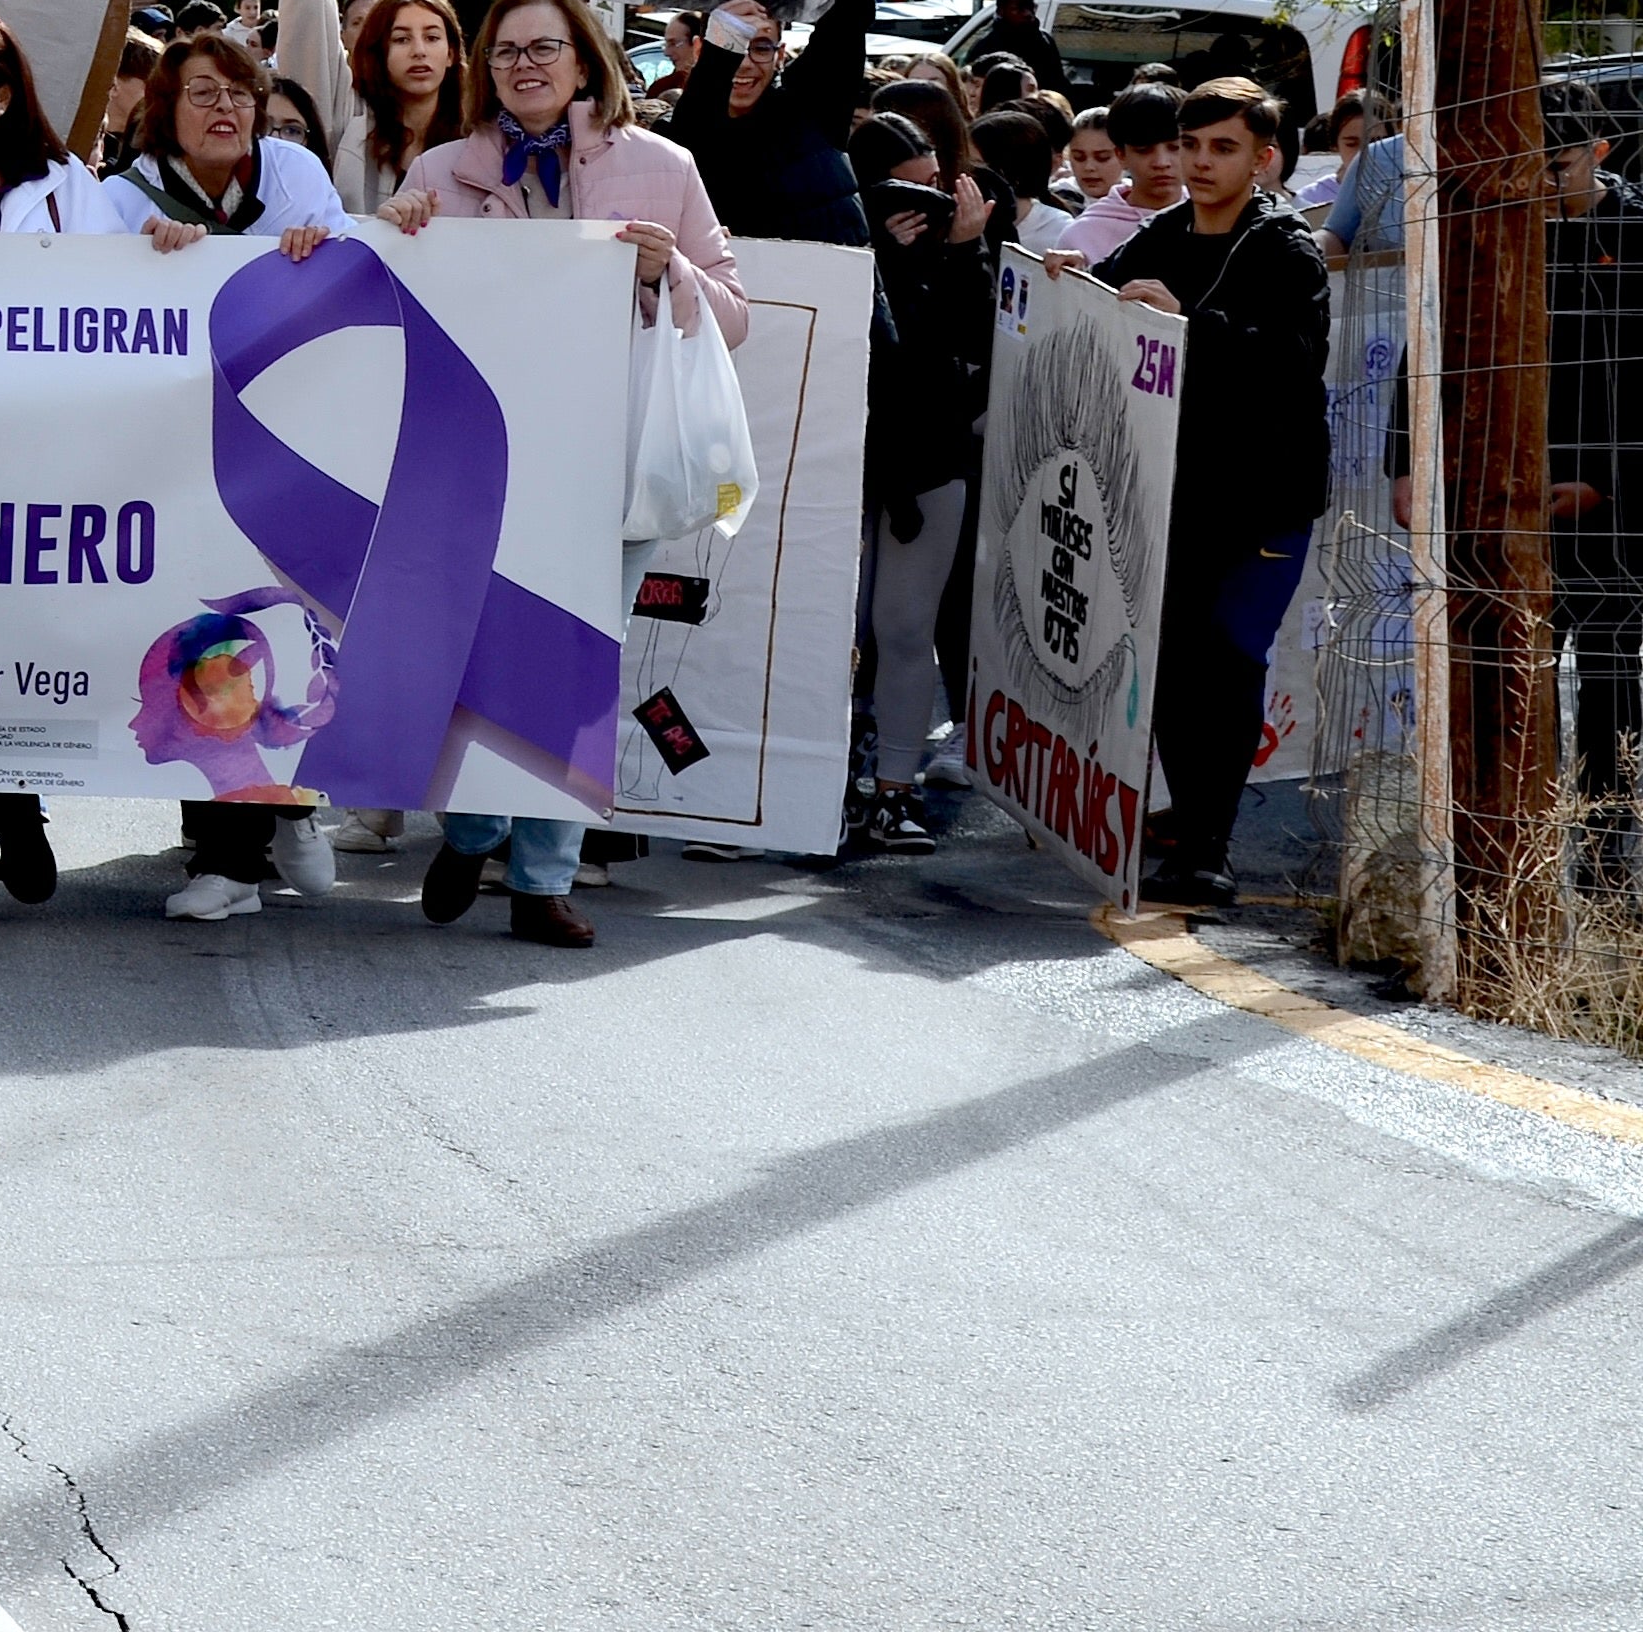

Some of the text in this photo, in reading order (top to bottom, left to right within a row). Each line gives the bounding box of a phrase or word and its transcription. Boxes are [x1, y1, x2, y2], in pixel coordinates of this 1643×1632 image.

[1131, 334, 1177, 398] 25N
[14, 662, 90, 705] Vega
[26, 770, 64, 778] GOBIERNO
